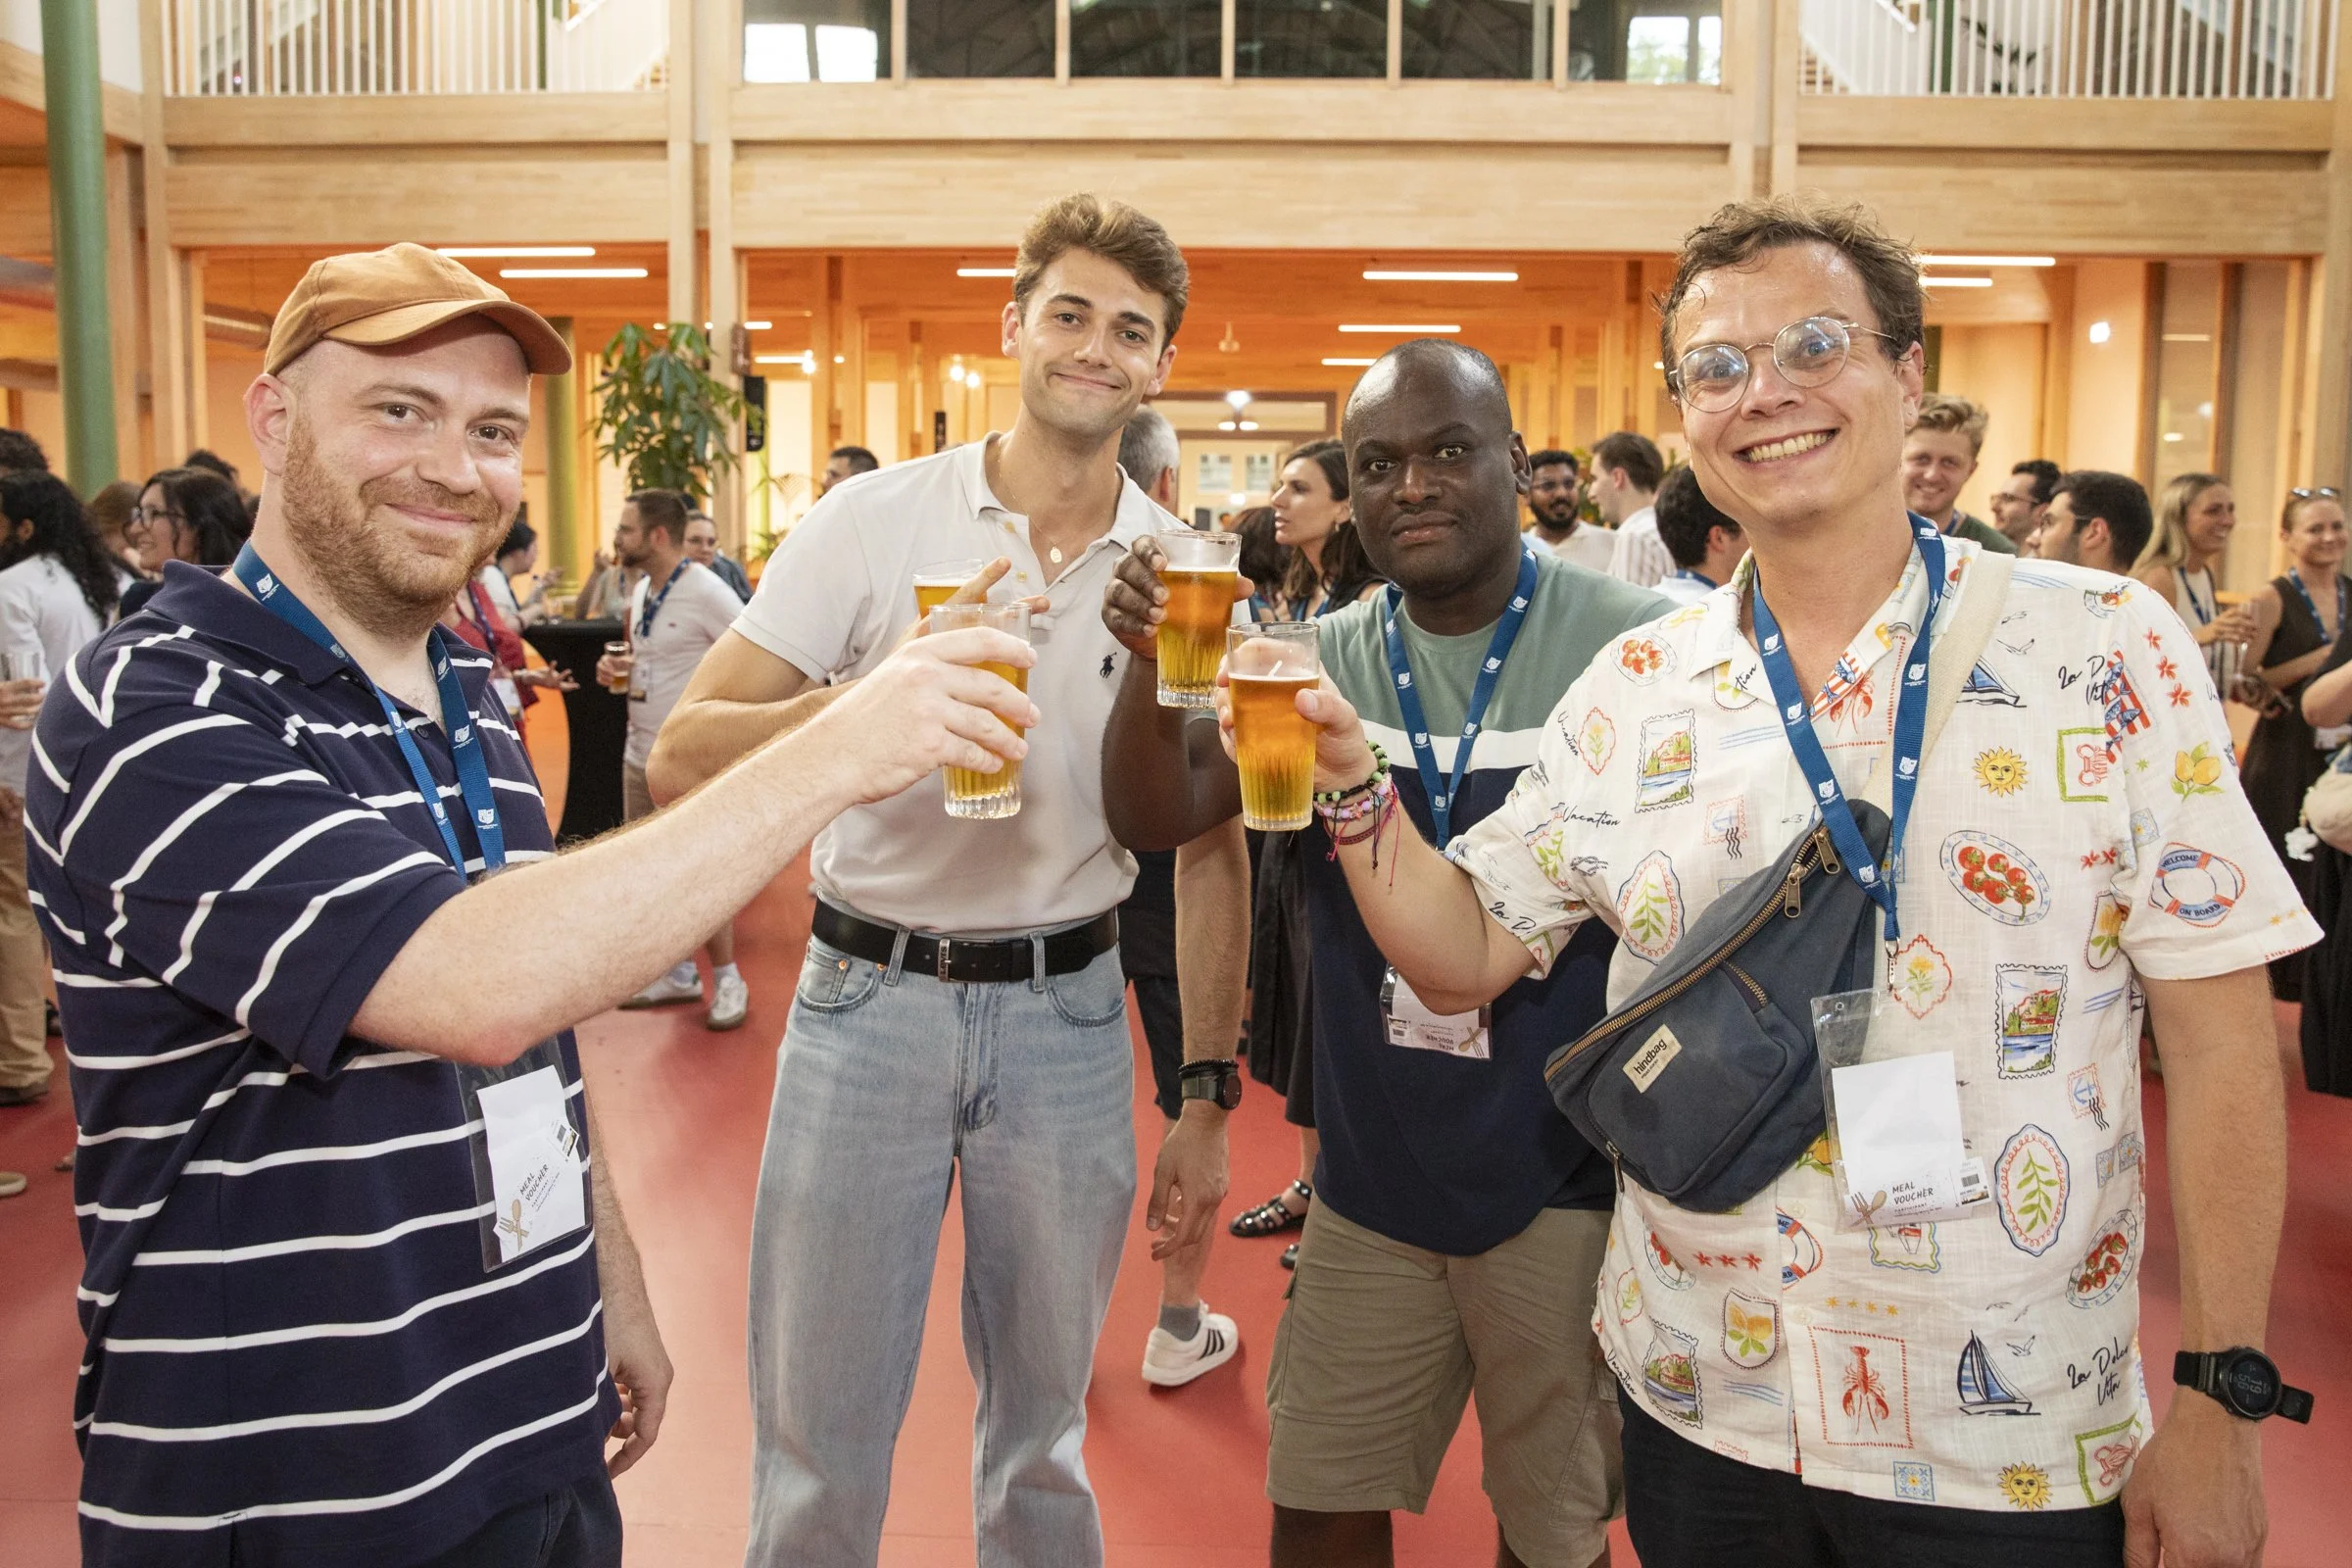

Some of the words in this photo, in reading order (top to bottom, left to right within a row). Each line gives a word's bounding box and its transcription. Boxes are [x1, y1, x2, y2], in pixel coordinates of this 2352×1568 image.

[1563, 805, 1622, 828] Vacation
[2161, 855, 2199, 867] WELCOME
[2179, 907, 2191, 916] ON
[2194, 903, 2221, 917] BOARD
[1633, 1039, 1667, 1075] hindbag
[519, 1172, 535, 1196] MEAL
[525, 1163, 549, 1201] VOUCHER
[1892, 1181, 1916, 1195] MEAL
[1893, 1187, 1934, 1205] VOUCHER
[2250, 1379, 2263, 1395] 19
